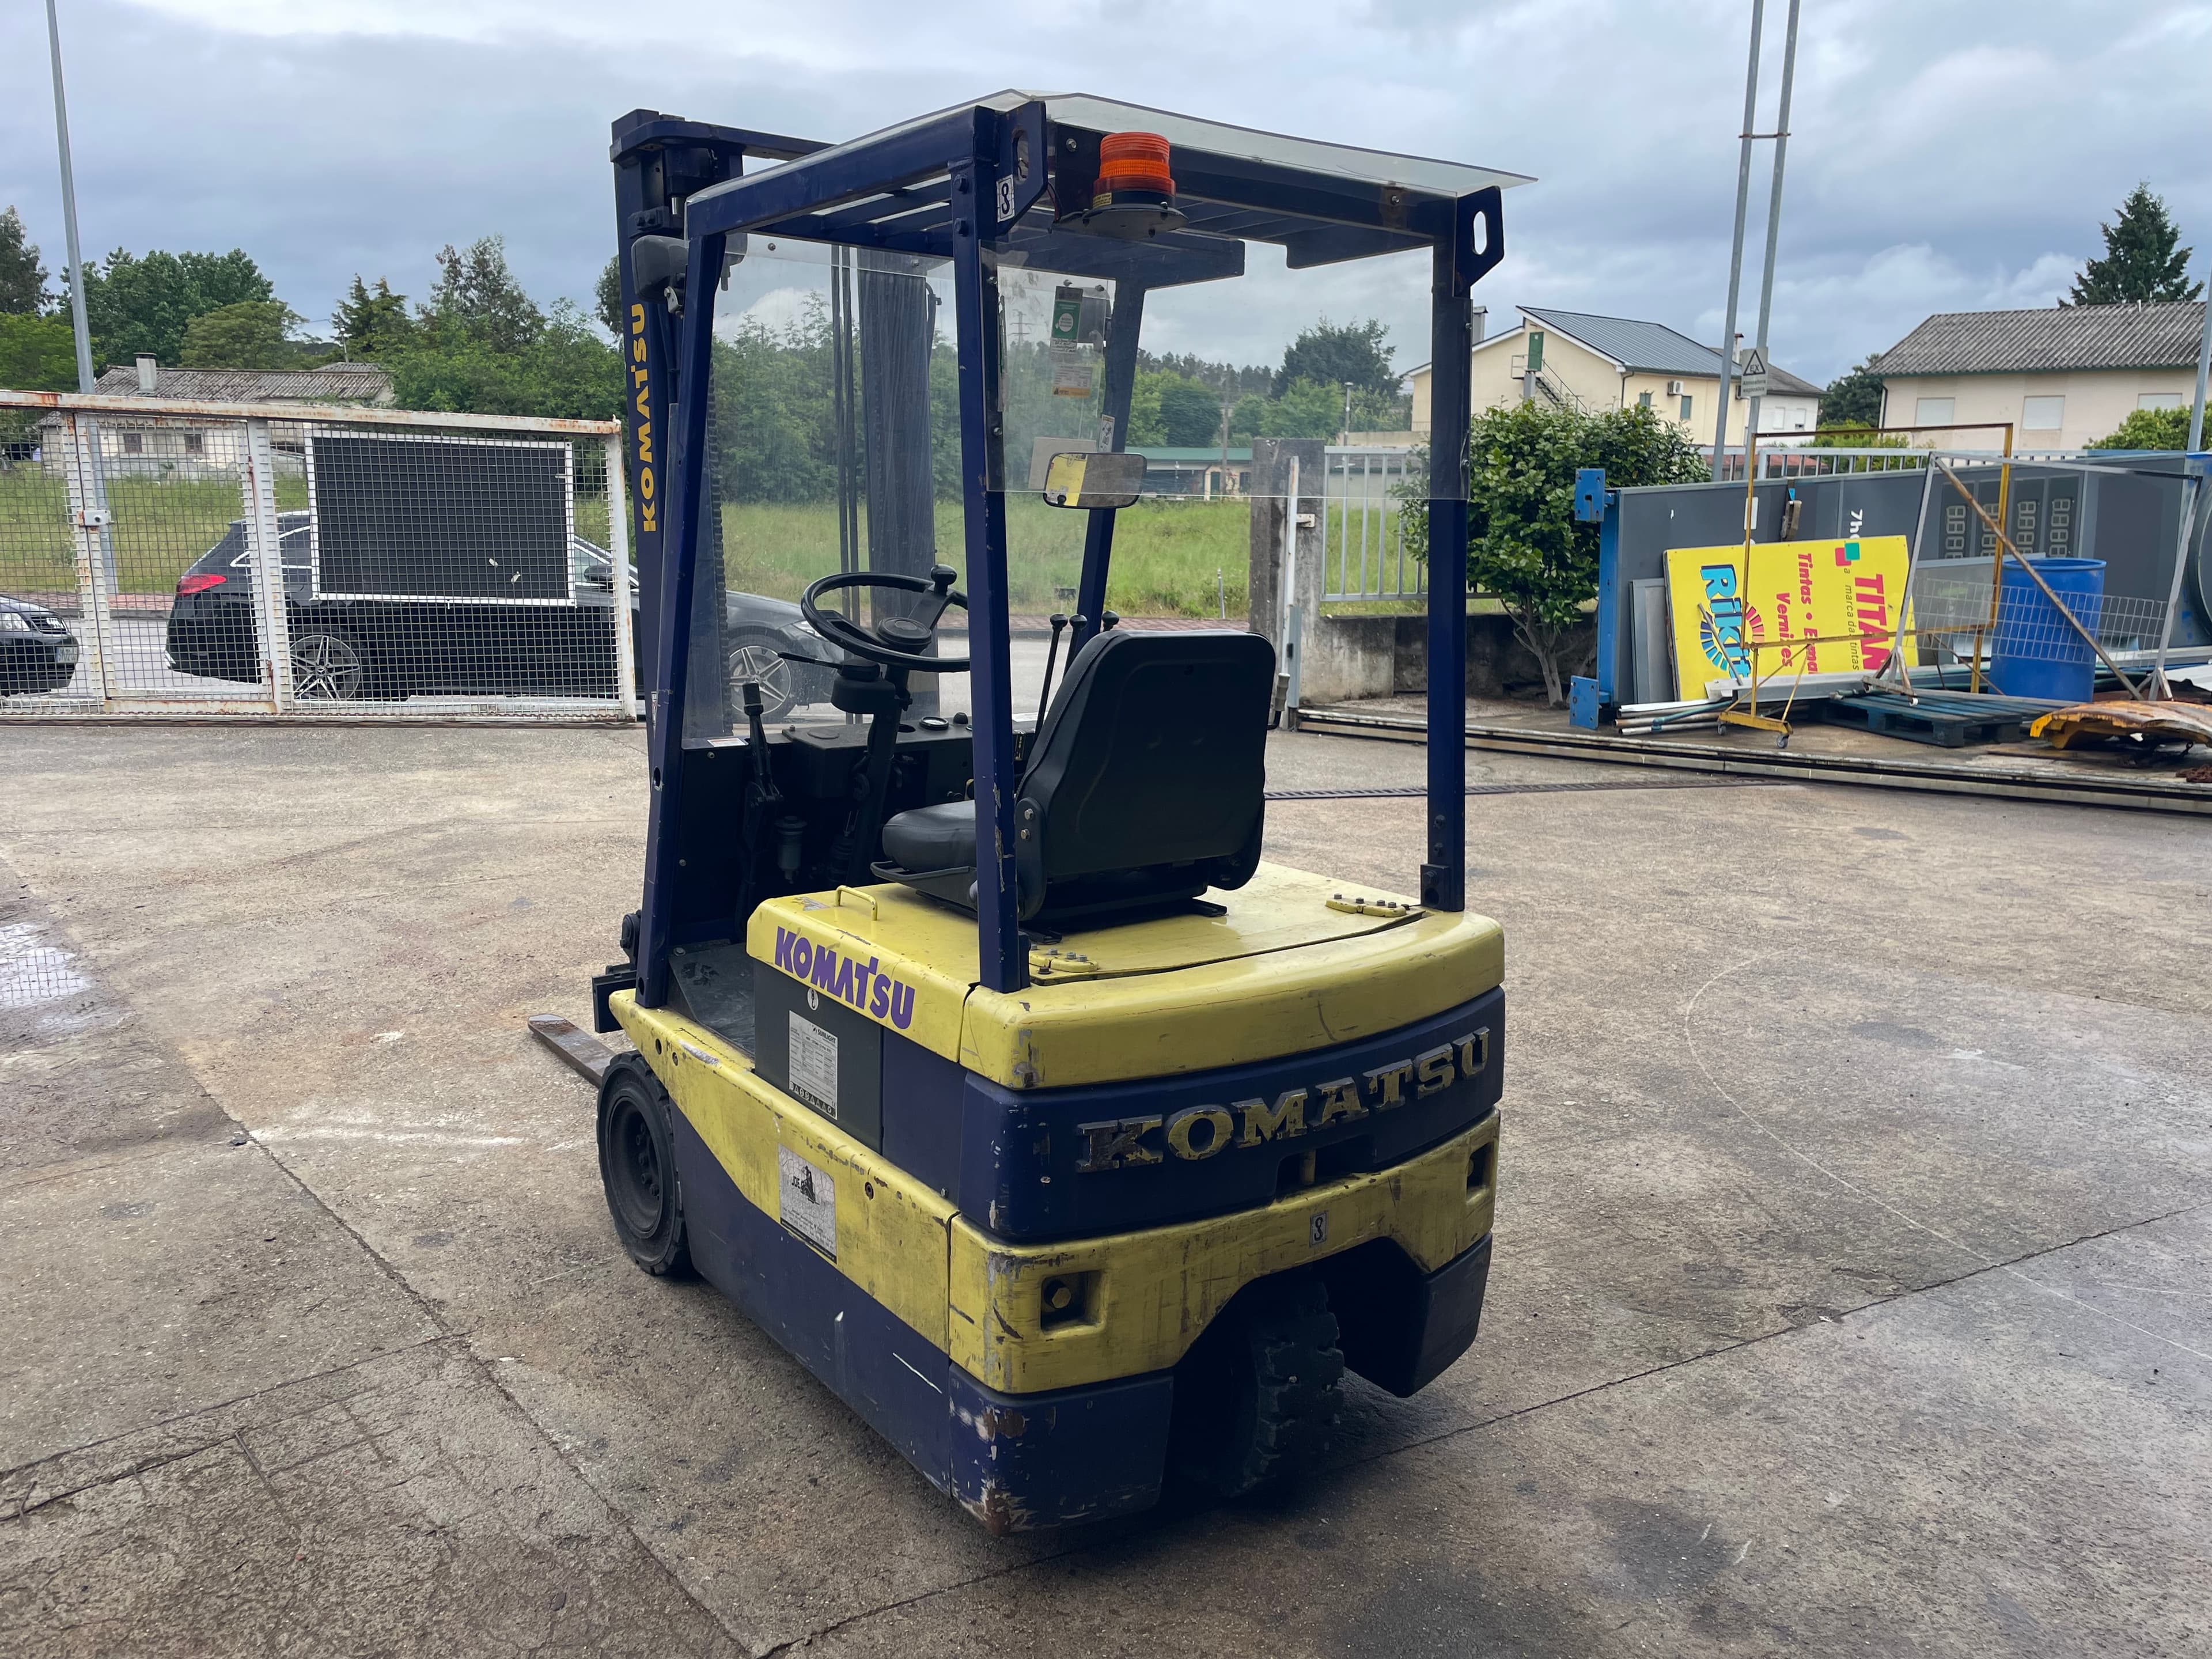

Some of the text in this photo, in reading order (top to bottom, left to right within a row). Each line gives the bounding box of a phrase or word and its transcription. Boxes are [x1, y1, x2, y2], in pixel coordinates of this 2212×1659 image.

[1750, 364, 1760, 372] EX
[631, 304, 657, 532] KOMATSU
[1798, 553, 1813, 605] Tintas
[1845, 585, 1854, 618] marca
[1776, 593, 1794, 667] Vernies
[1848, 620, 1857, 637] da
[1854, 573, 1891, 670] TITAN
[1850, 642, 1859, 671] tintas
[775, 925, 916, 1030] KOMATSU
[1075, 1026, 1490, 1173] KOMATSU
